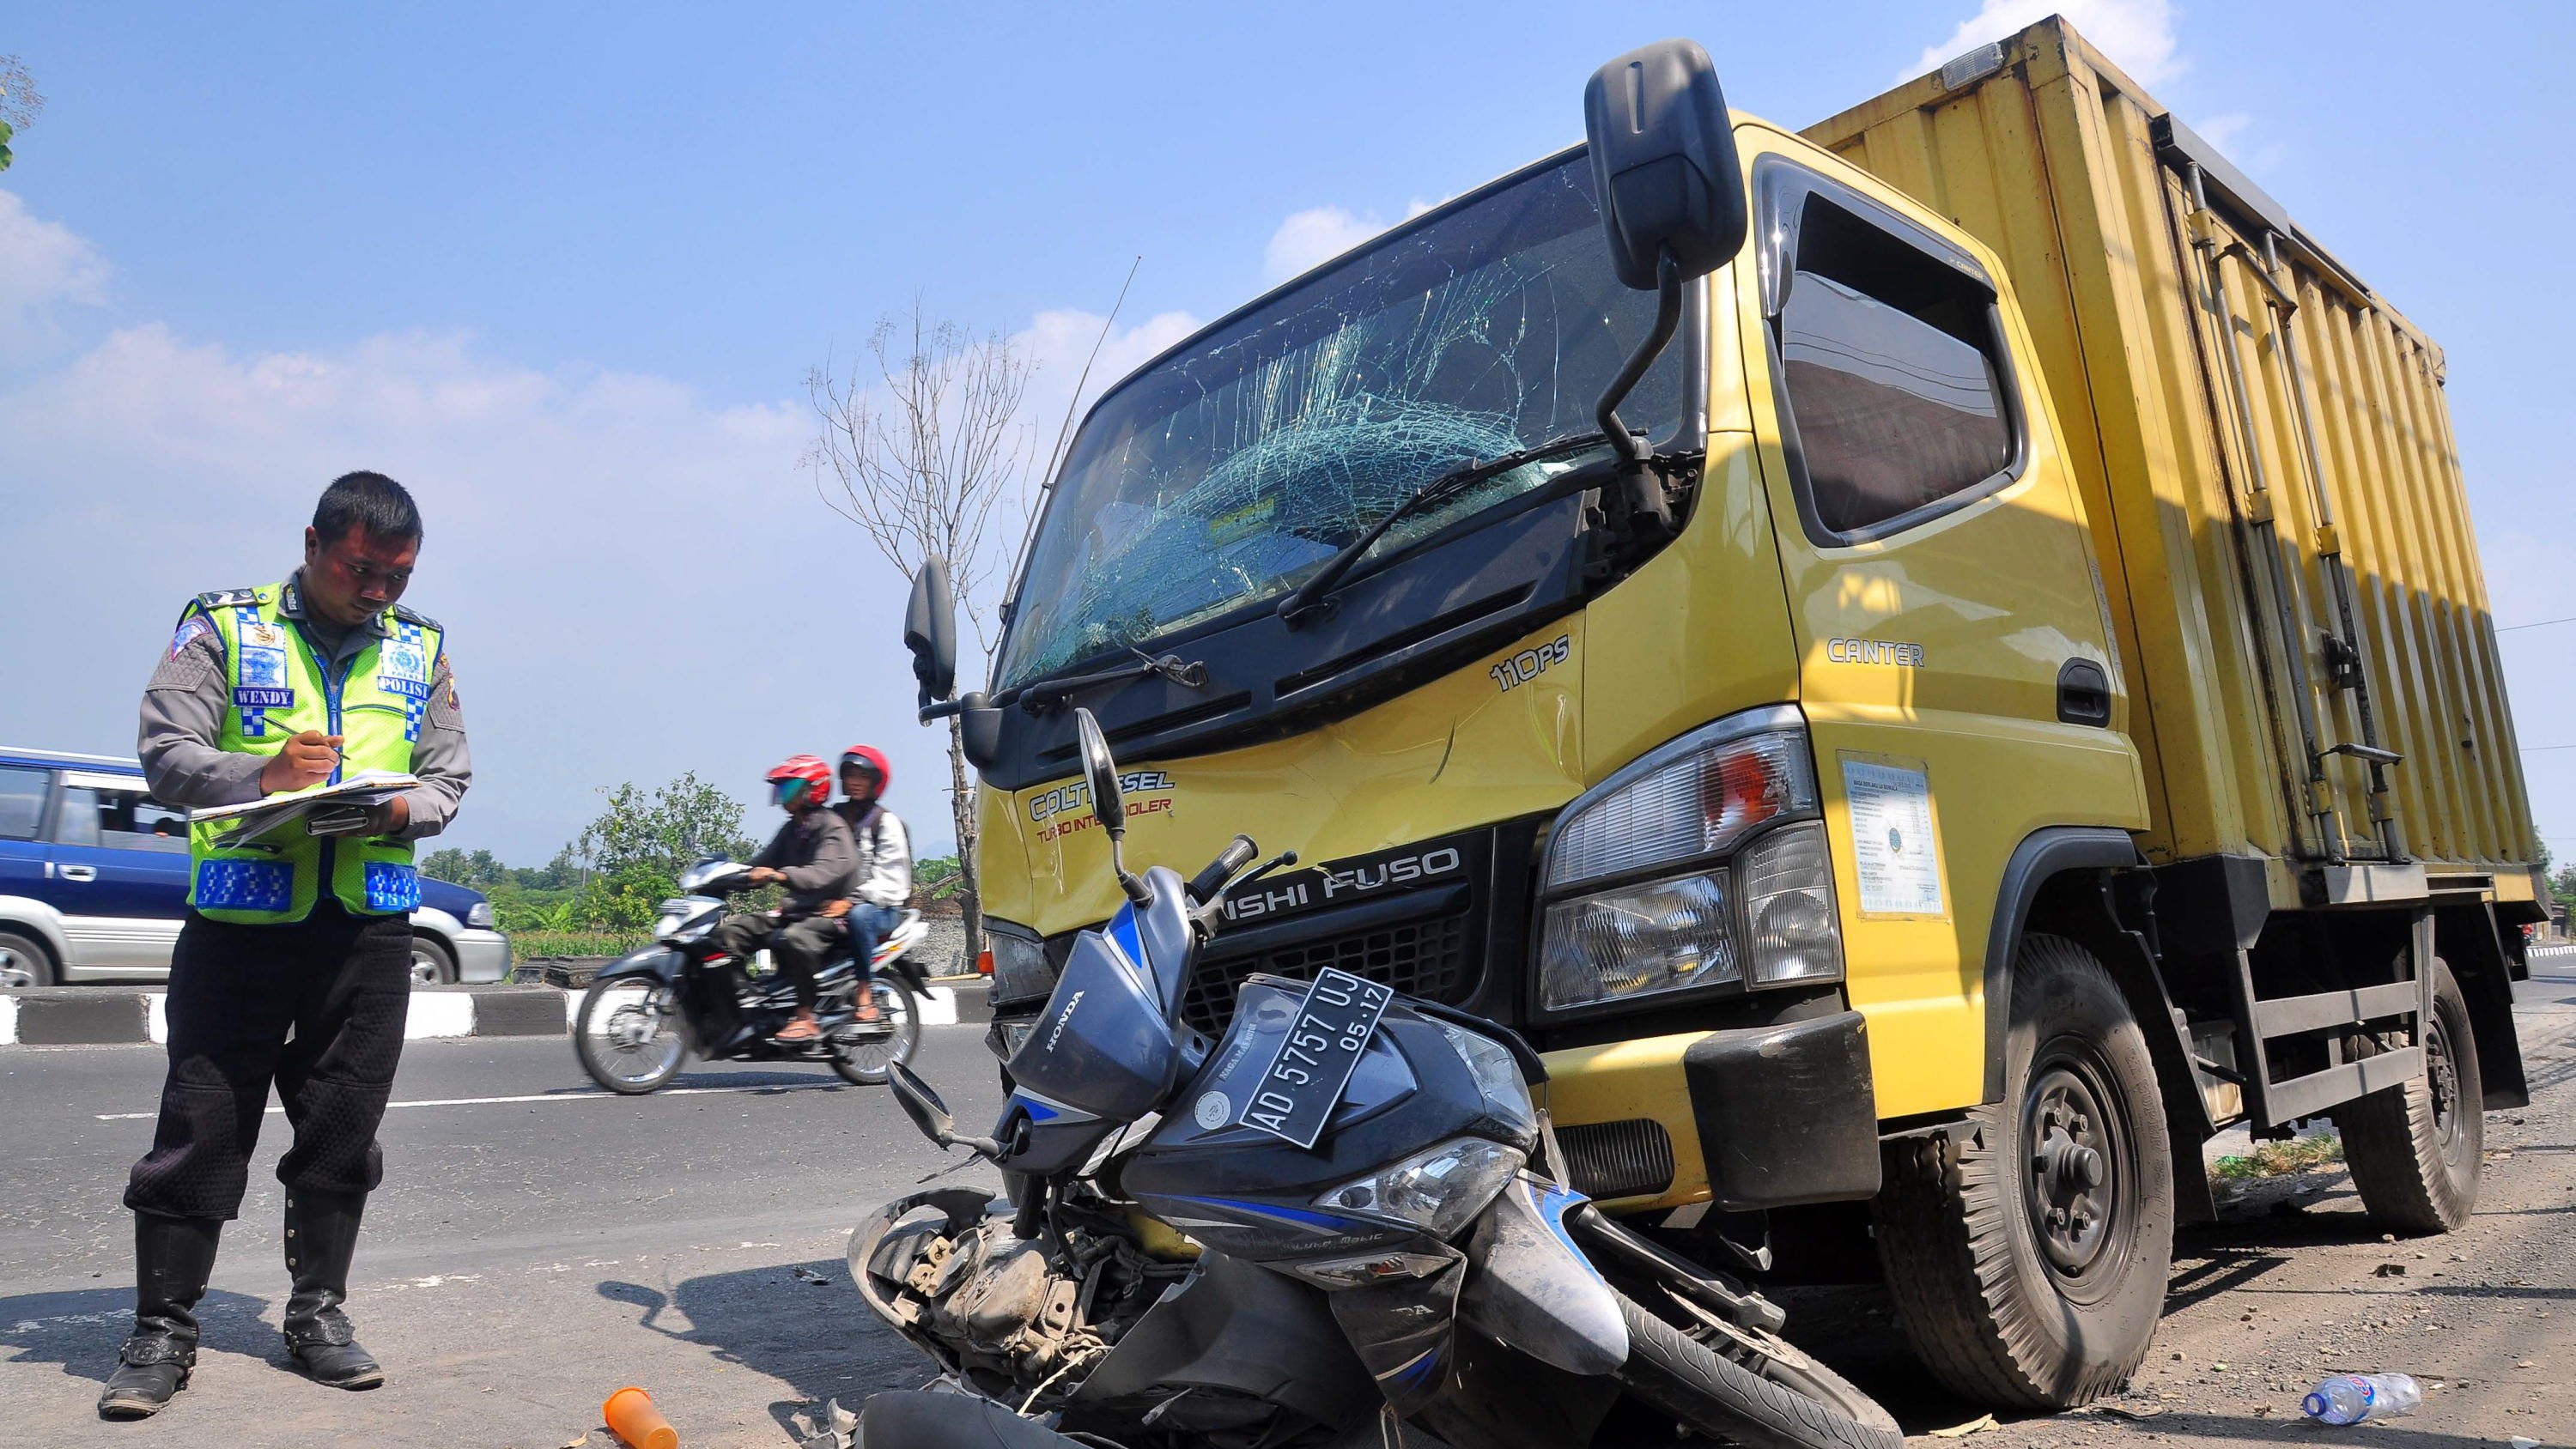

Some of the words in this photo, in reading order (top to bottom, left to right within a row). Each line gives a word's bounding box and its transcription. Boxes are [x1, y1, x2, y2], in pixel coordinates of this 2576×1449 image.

[1489, 634, 1569, 692] 110PS
[1827, 638, 1925, 667] CANTER
[238, 690, 289, 705] WENDY
[378, 677, 428, 699] POLISI
[1030, 782, 1087, 822] COLT
[1323, 848, 1460, 898] FUSO
[1046, 991, 1084, 1053] HONDA
[1251, 1092, 1294, 1131] AD
[1273, 1014, 1336, 1085] 5757
[1315, 972, 1358, 1007] UJ
